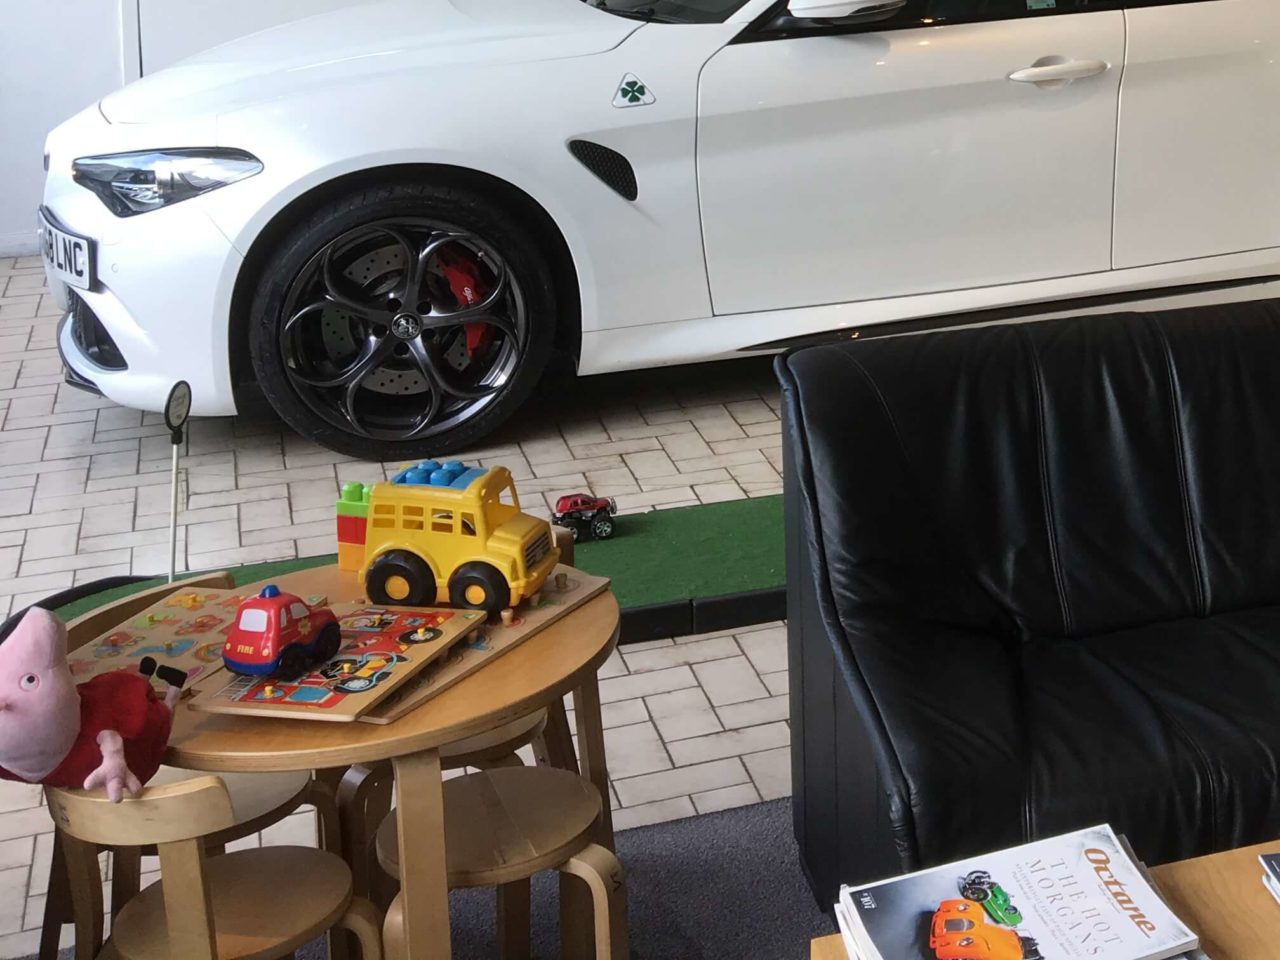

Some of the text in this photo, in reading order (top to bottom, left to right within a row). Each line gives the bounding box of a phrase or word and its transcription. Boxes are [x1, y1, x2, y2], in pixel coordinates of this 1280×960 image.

[55, 233, 84, 277] LNC
[237, 644, 254, 655] FIRE
[860, 896, 875, 909] 107
[1026, 859, 1104, 955] MORGANS
[1051, 858, 1087, 903] THE
[1081, 907, 1123, 944] HOT
[1084, 848, 1156, 938] Octane
